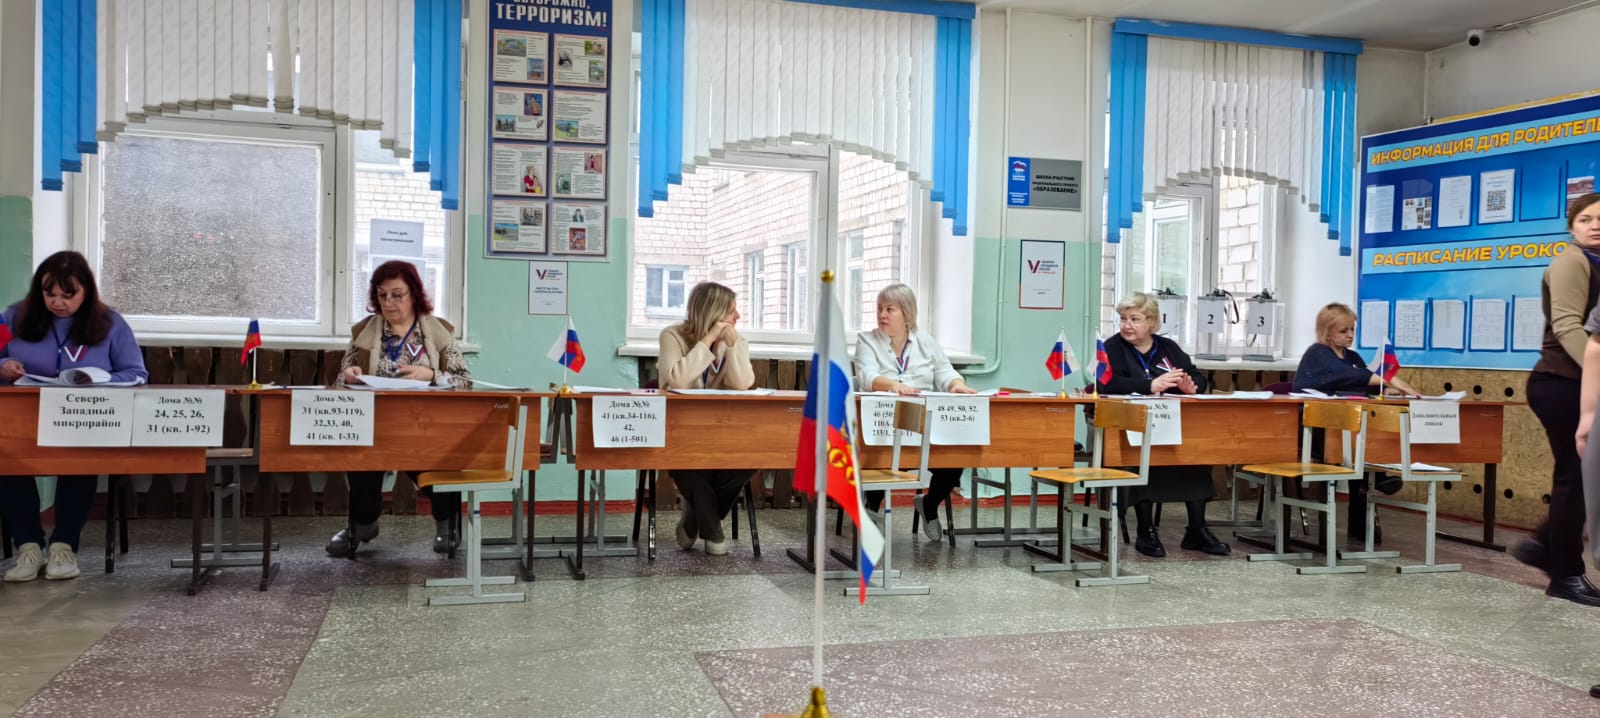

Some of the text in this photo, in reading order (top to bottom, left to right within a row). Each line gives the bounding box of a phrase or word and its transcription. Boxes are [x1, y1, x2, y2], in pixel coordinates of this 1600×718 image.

[496, 2, 607, 28] ТЕРРОРИЗМ!
[1371, 137, 1474, 166] ИНФОРМАЦИЯ
[1475, 133, 1510, 153] ДЛЯ
[1372, 241, 1569, 267] РАСПИСАНИЕ УРОКО
[1208, 314, 1214, 325] 2
[1257, 316, 1264, 328] 3
[66, 393, 109, 404] Северо-
[157, 396, 181, 405] Дома
[313, 394, 335, 402] Дома
[609, 400, 631, 409] Дома
[874, 401, 894, 409] Дома
[60, 405, 115, 416] Западный
[154, 409, 205, 419] 24, 25, 26,
[302, 406, 311, 415] 31
[601, 412, 610, 420] 41
[53, 418, 121, 430] микрорайон
[147, 424, 211, 435] 31 (кв. 1-92)
[306, 432, 315, 441] 41
[611, 435, 648, 444] 46 (1-501)
